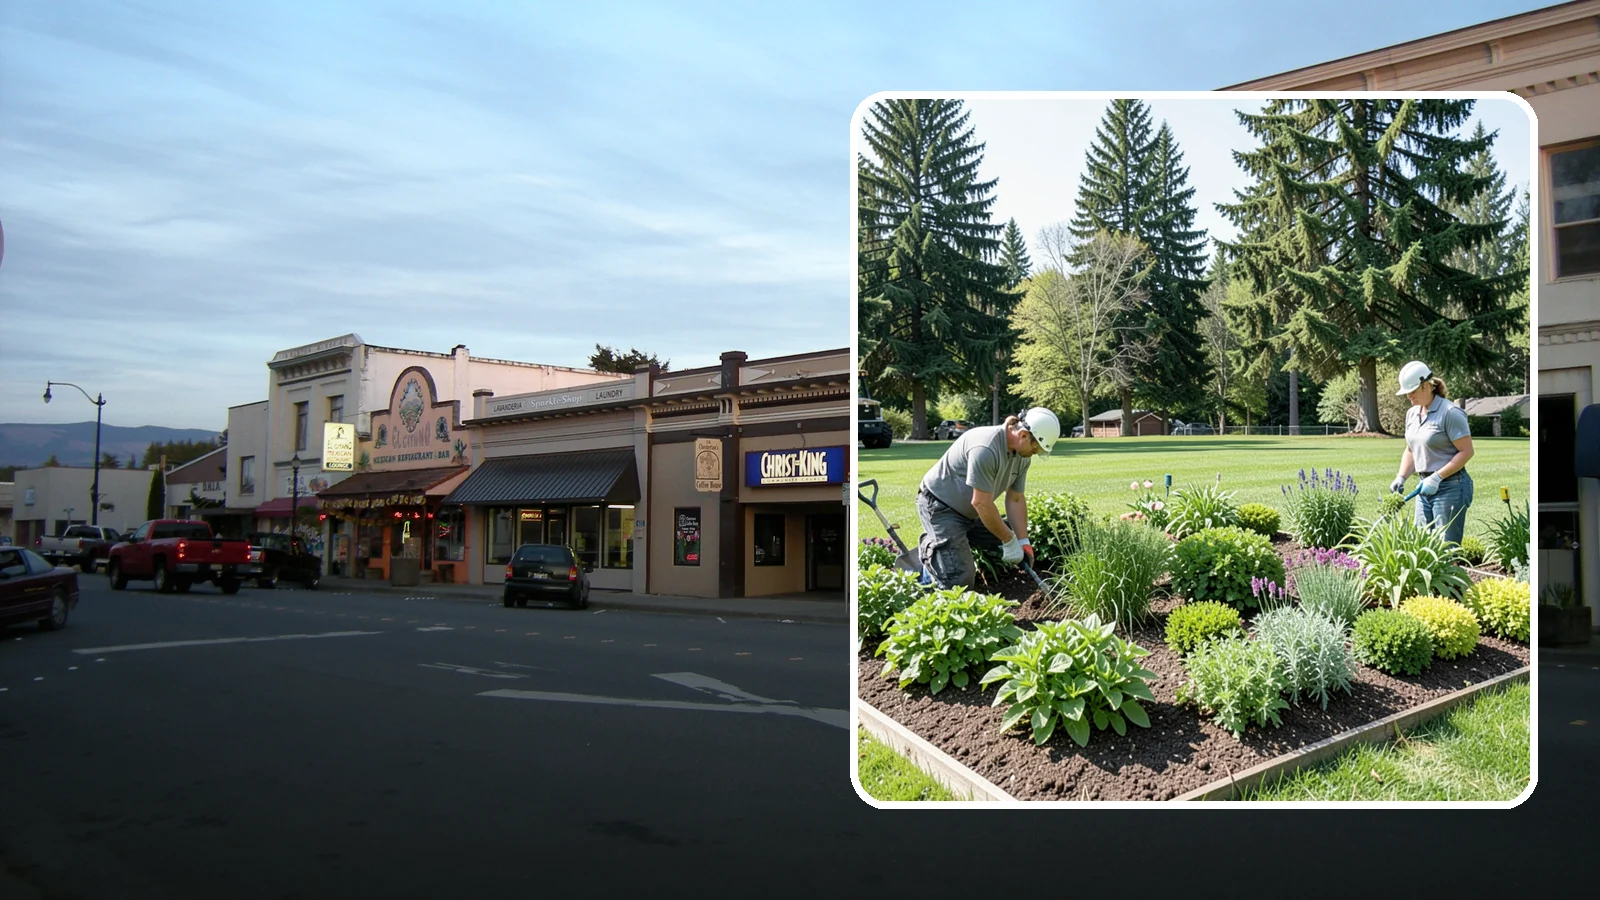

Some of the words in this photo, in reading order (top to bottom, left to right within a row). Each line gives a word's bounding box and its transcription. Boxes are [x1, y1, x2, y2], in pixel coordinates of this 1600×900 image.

[494, 401, 523, 413] LAVANDERIA
[530, 397, 560, 409] Sparkle
[561, 394, 583, 405] Shop
[595, 389, 624, 400] LAUNDRY
[374, 455, 396, 464] MEXICAN
[397, 451, 434, 463] RESTAURANT
[437, 450, 450, 459] BAR
[761, 452, 798, 478] CHRIST
[799, 450, 828, 477] KING
